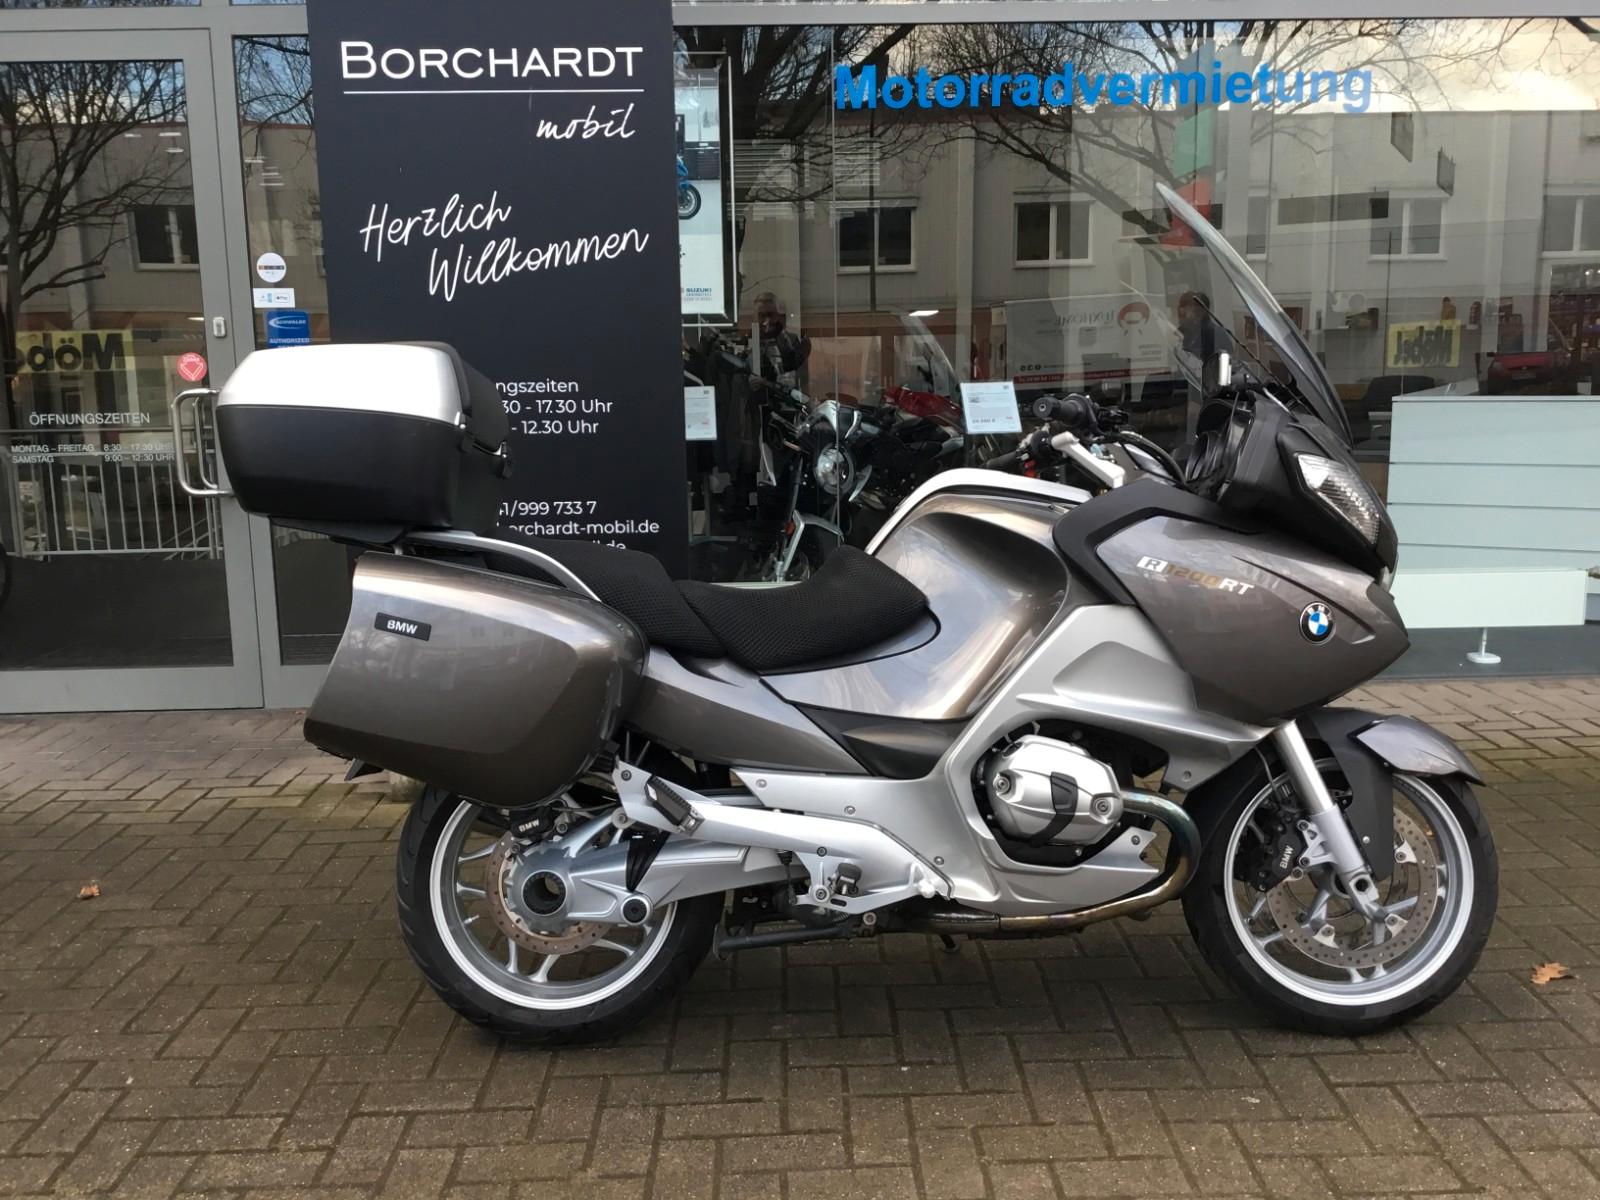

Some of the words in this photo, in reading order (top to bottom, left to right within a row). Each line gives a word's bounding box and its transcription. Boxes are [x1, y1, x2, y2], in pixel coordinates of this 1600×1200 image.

[340, 41, 643, 79] BORCHARDT
[834, 62, 1372, 113] Motorradvermietung
[536, 103, 635, 139] mobil
[359, 190, 512, 263] Herzlich
[428, 228, 649, 302] Willkommen
[495, 378, 579, 396] ngszeiten
[502, 399, 521, 414] 30
[536, 399, 577, 414] 17.30
[581, 398, 613, 413] Uhr
[29, 411, 150, 426] ÖFFNUNGSZEITEN
[521, 420, 563, 434] 12.30
[567, 419, 599, 434] Uhr
[11, 444, 49, 453] MONTAG
[58, 443, 94, 452] FREITAG
[12, 455, 54, 463] SAMSTAG
[156, 453, 175, 462] UHR
[553, 502, 583, 515] 733
[586, 501, 597, 515] 7
[496, 520, 660, 536] rchardt-mobil.de
[387, 619, 418, 635] BMW
[518, 818, 540, 832] BMW
[1279, 844, 1294, 869] BMW
